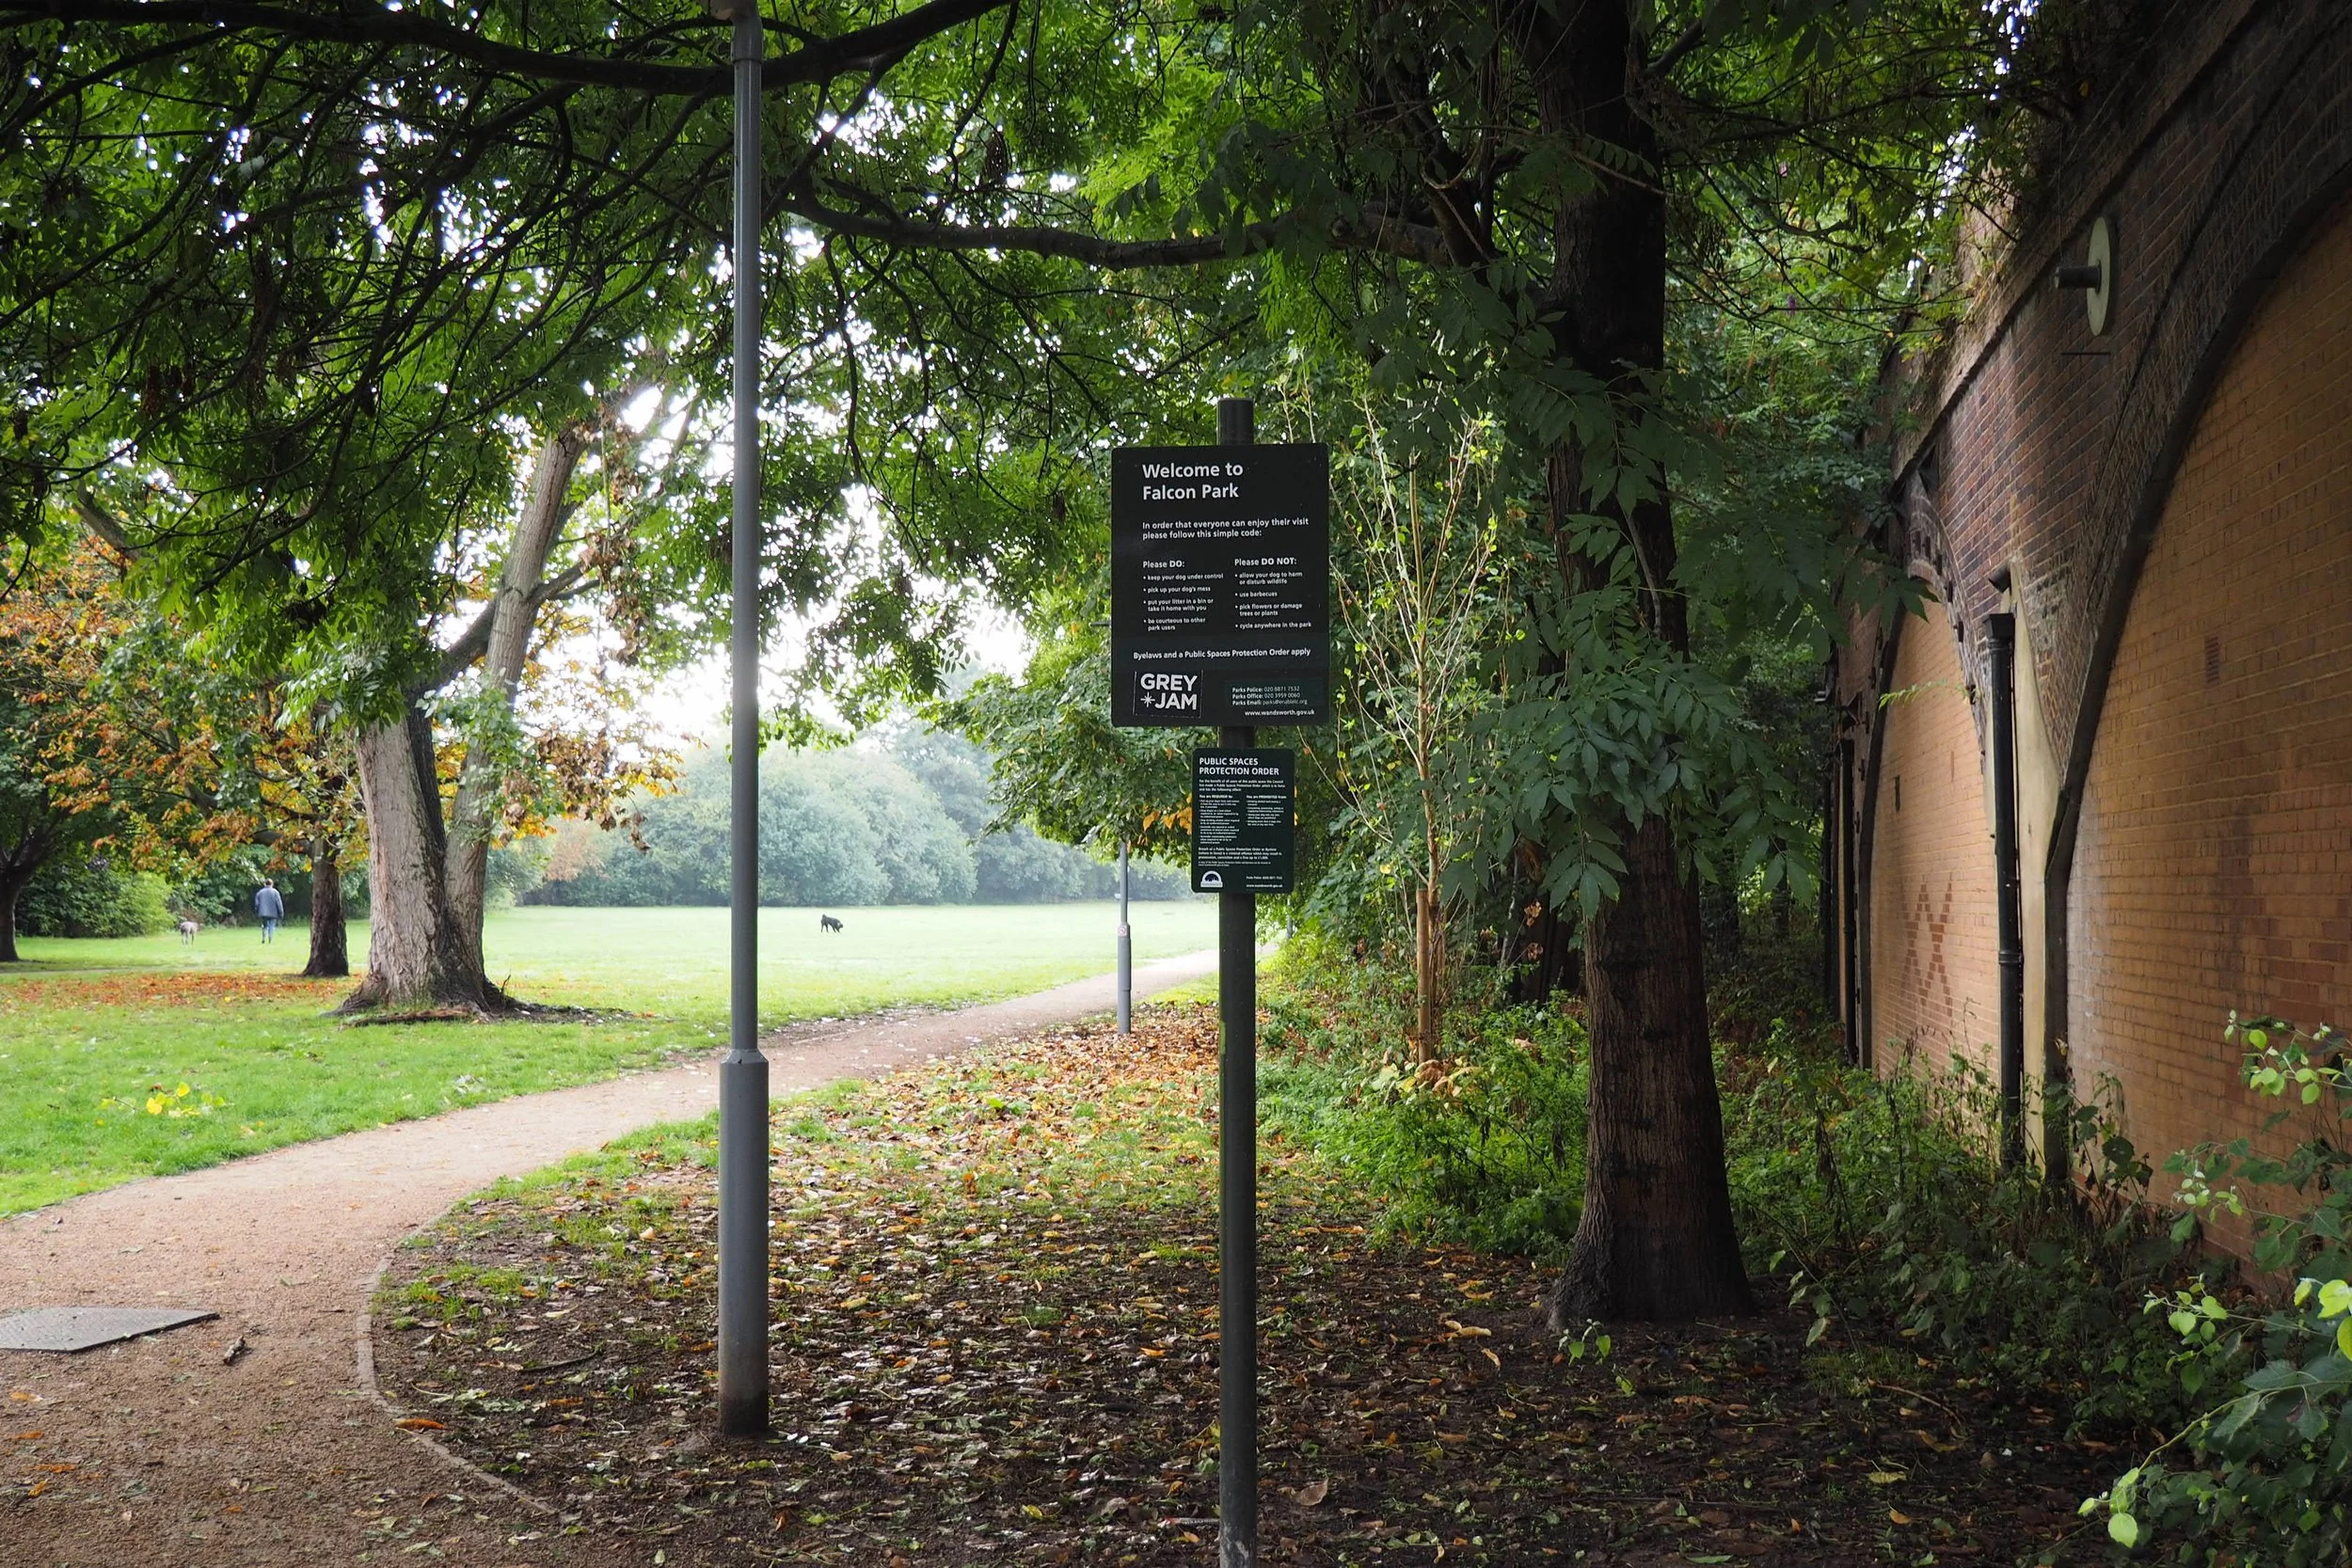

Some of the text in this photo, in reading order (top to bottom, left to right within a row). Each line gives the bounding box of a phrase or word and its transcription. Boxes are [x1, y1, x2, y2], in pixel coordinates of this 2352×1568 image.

[1142, 462, 1243, 478] Welcome to
[1143, 483, 1239, 500] Falcon Park
[1193, 521, 1230, 529] everyone
[1247, 518, 1269, 528] enjoy
[1292, 517, 1309, 525] visit
[1143, 531, 1167, 541] please
[1197, 530, 1211, 538] this
[1213, 529, 1239, 538] simple
[1133, 652, 1162, 660] Byelaws
[1207, 650, 1230, 659] Spaces
[1291, 648, 1311, 656] apply
[1140, 673, 1198, 691] GREY
[1155, 693, 1197, 710] JAM
